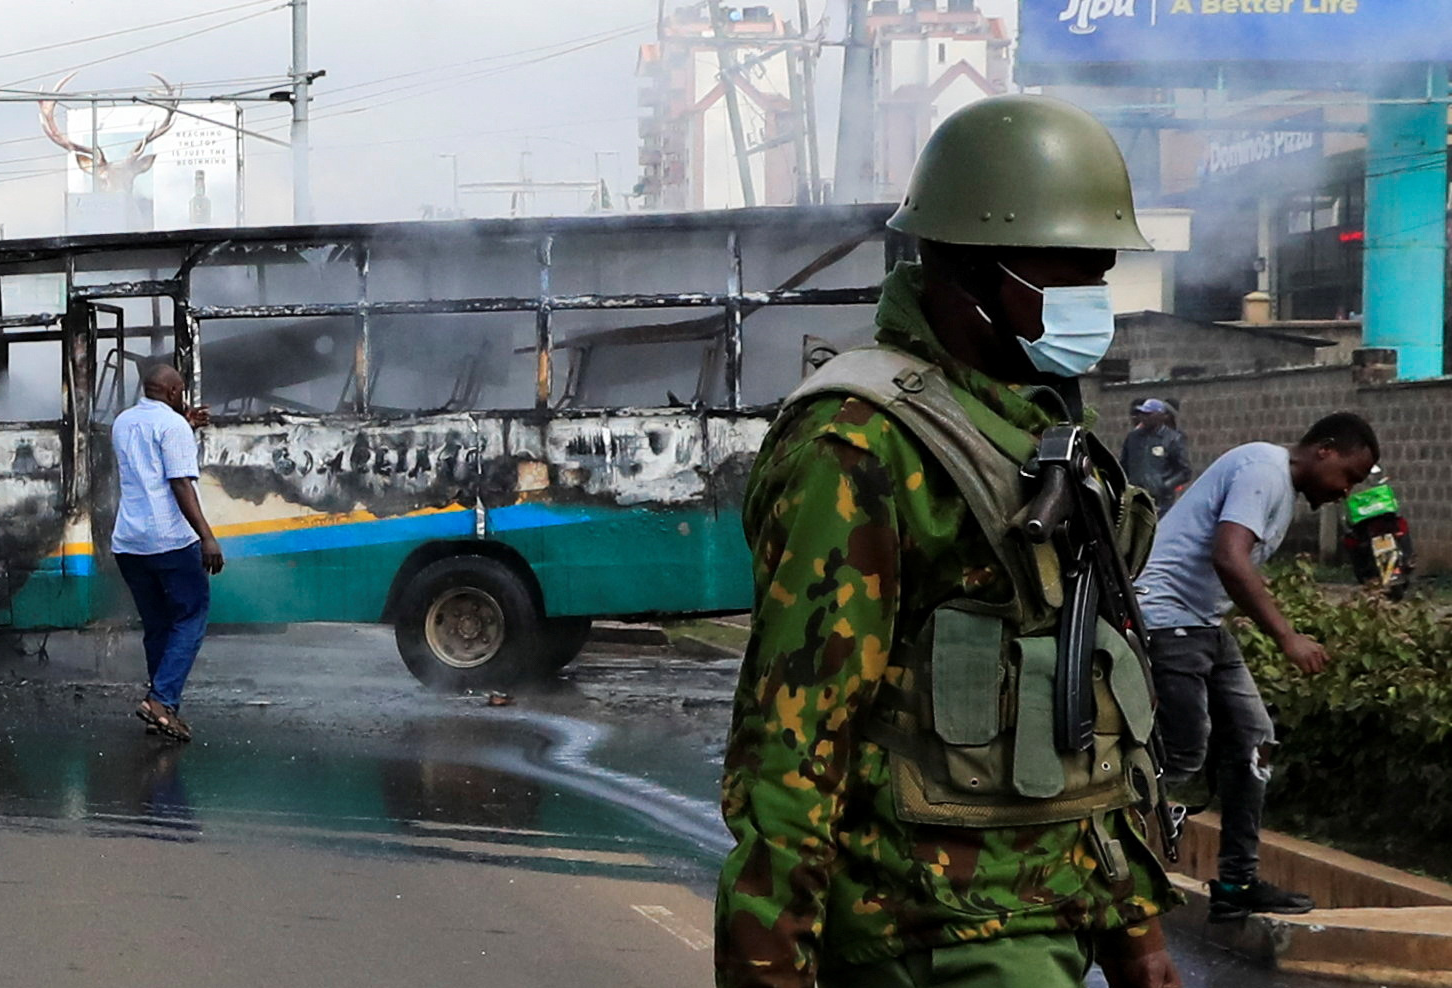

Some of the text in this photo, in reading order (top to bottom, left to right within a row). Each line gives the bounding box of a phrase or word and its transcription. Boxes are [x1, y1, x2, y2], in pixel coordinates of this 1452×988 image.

[1170, 0, 1193, 14] A
[176, 130, 222, 138] REACHING
[176, 158, 227, 166] BEGINNING
